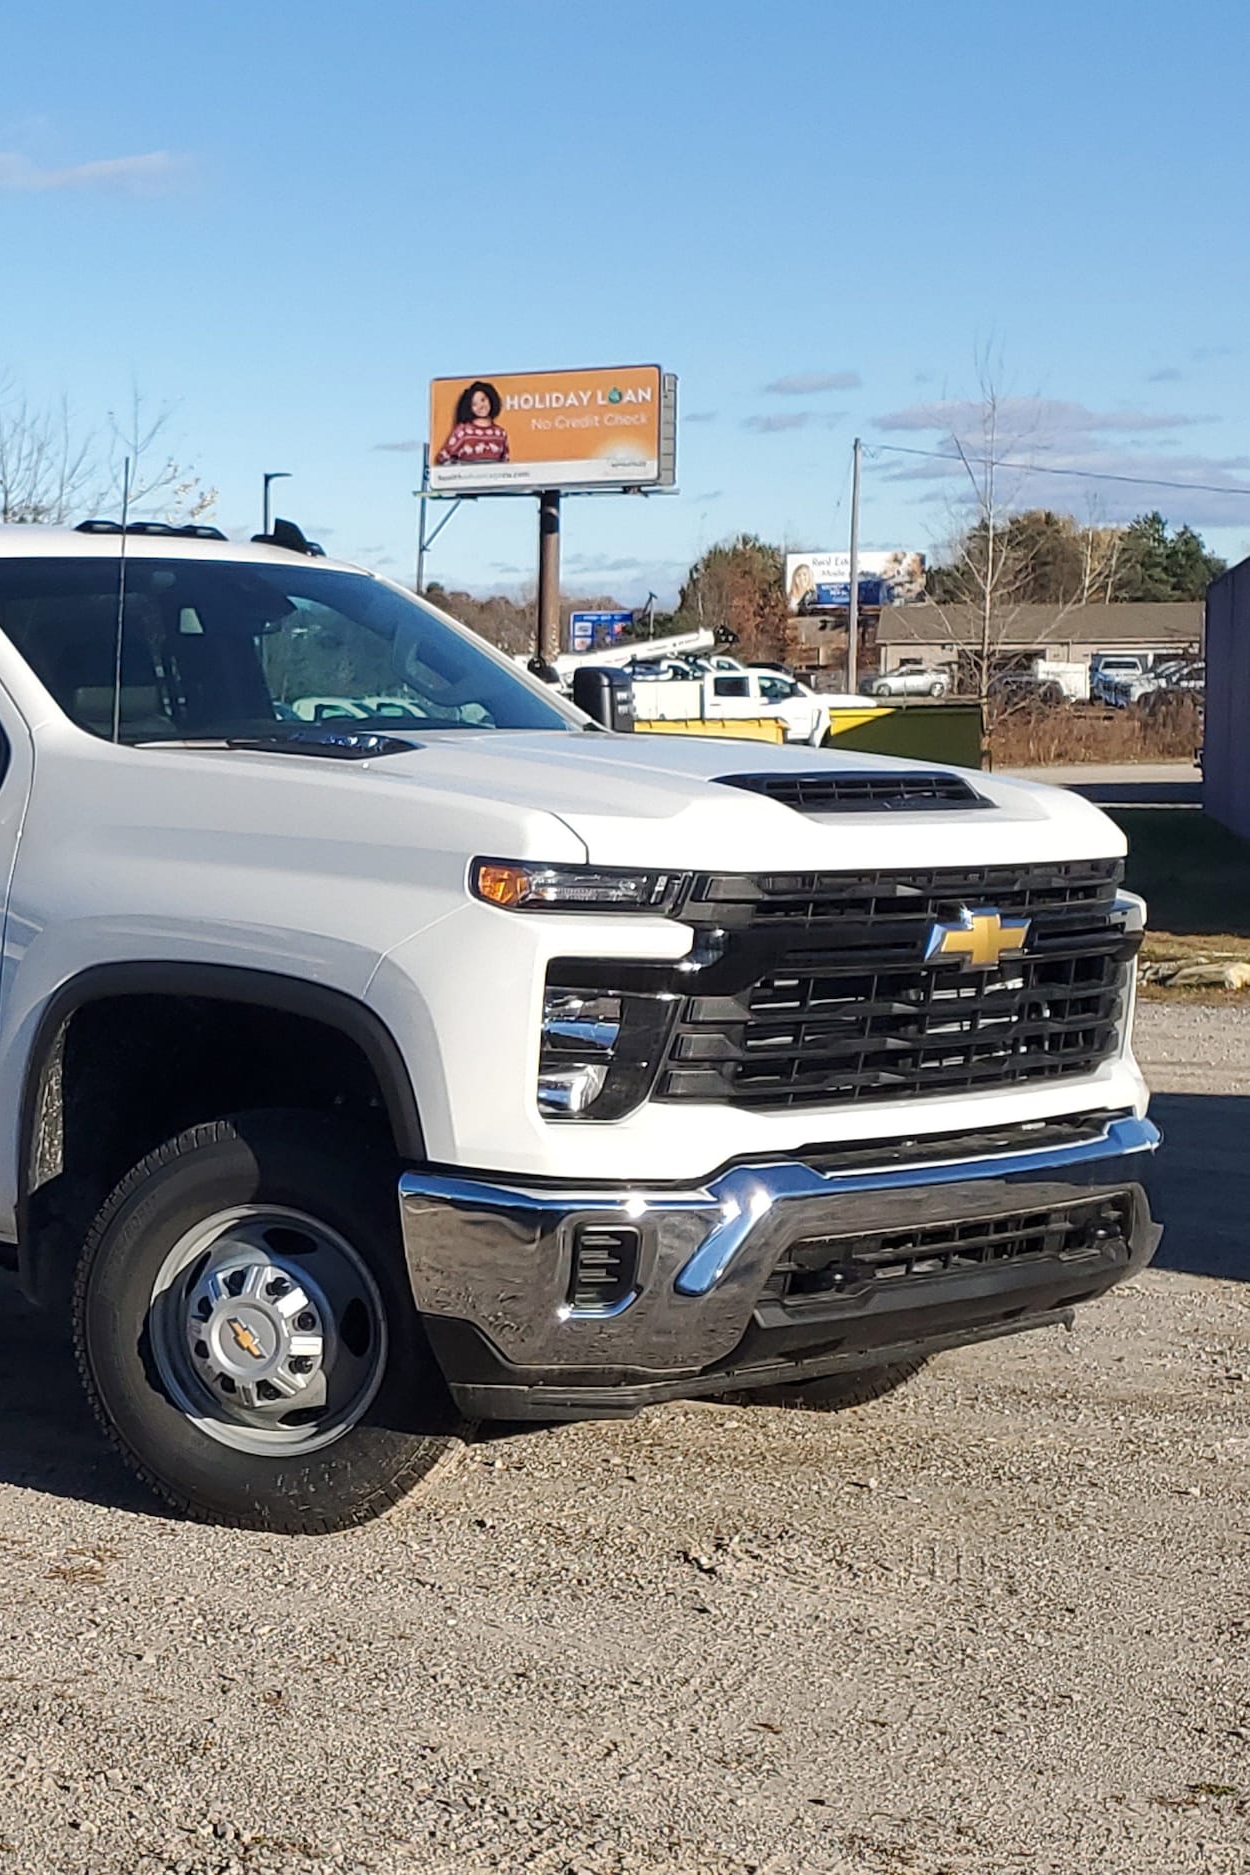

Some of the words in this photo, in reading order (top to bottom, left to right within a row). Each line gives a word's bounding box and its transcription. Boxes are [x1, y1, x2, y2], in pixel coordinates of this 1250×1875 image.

[506, 390, 591, 410] HOLIDAY
[596, 386, 652, 405] LOAN
[530, 418, 552, 430] No
[554, 414, 599, 429] Credit
[603, 411, 647, 426] Check
